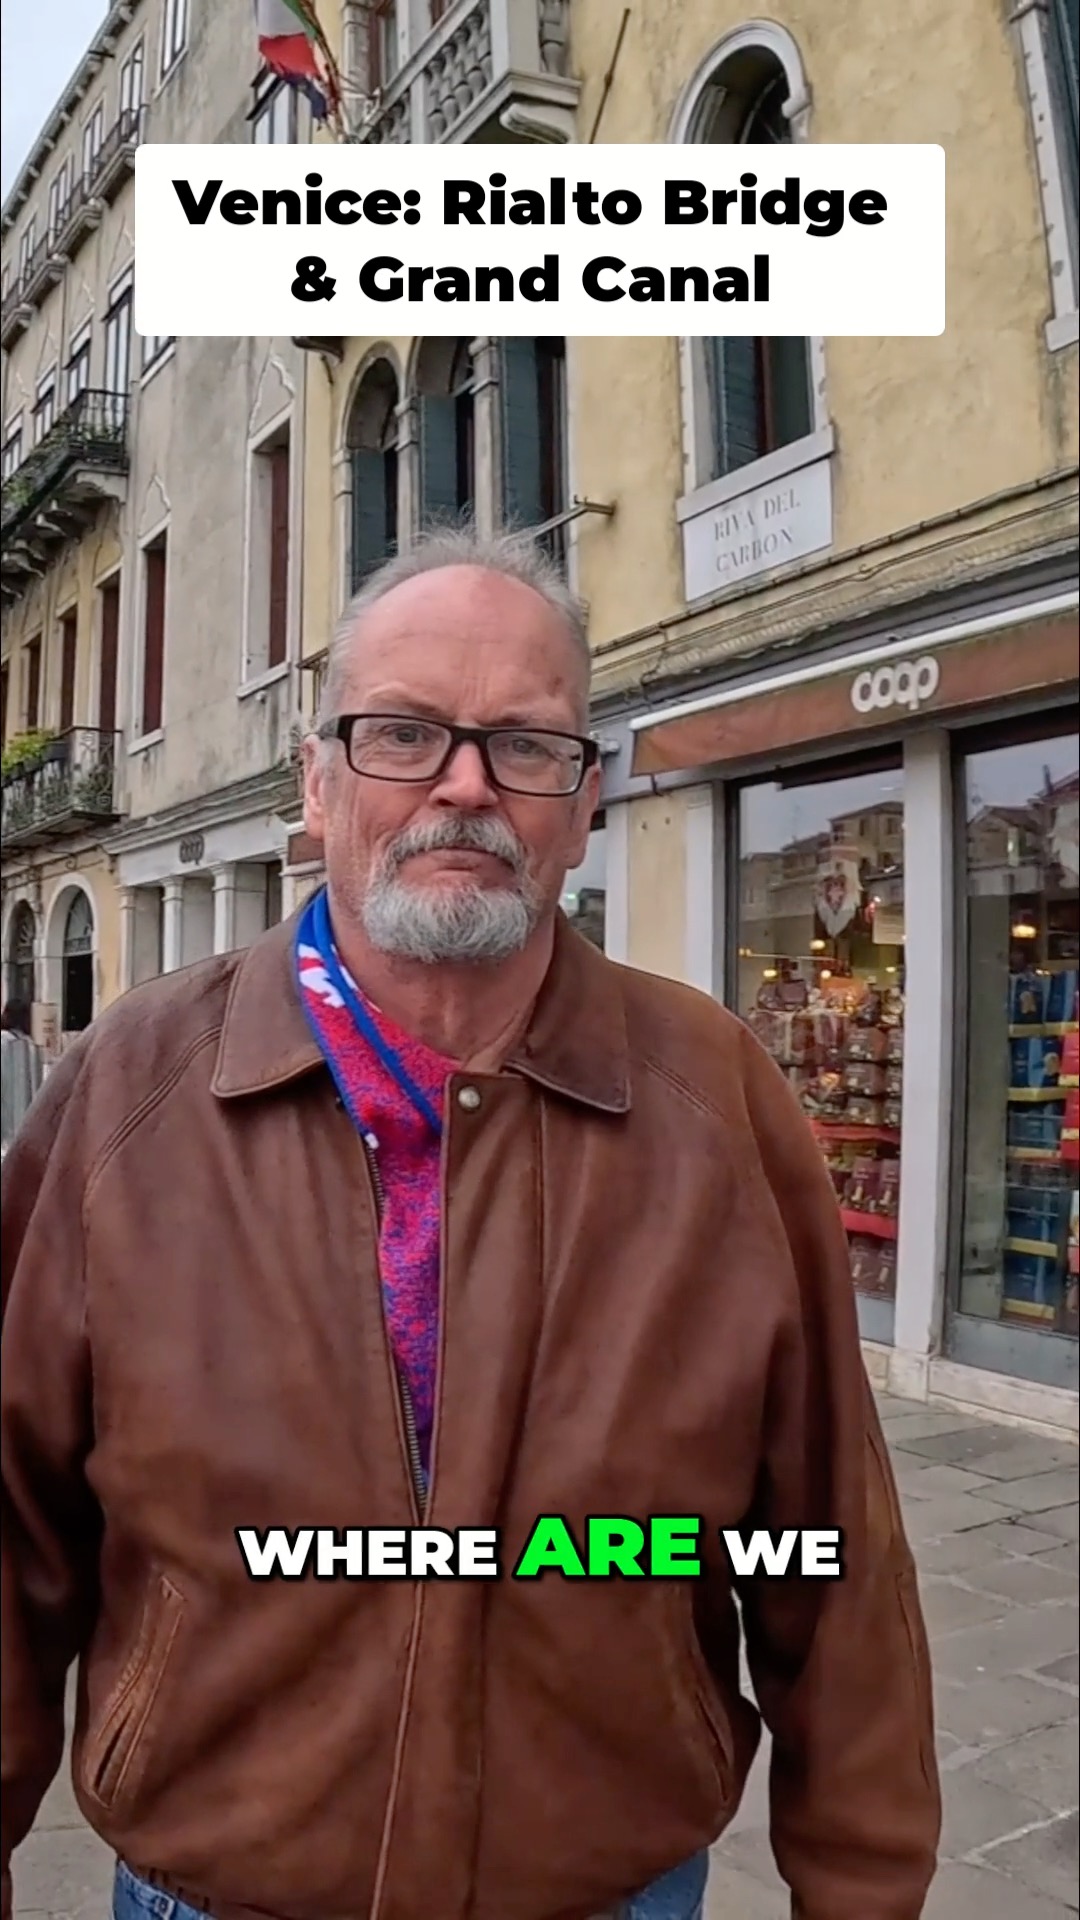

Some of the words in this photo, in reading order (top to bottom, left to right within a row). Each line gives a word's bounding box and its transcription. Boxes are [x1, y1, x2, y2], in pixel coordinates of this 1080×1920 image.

[714, 510, 755, 541] RIVA
[764, 488, 801, 519] DEL
[716, 526, 793, 572] CARBON
[851, 655, 940, 713] coop
